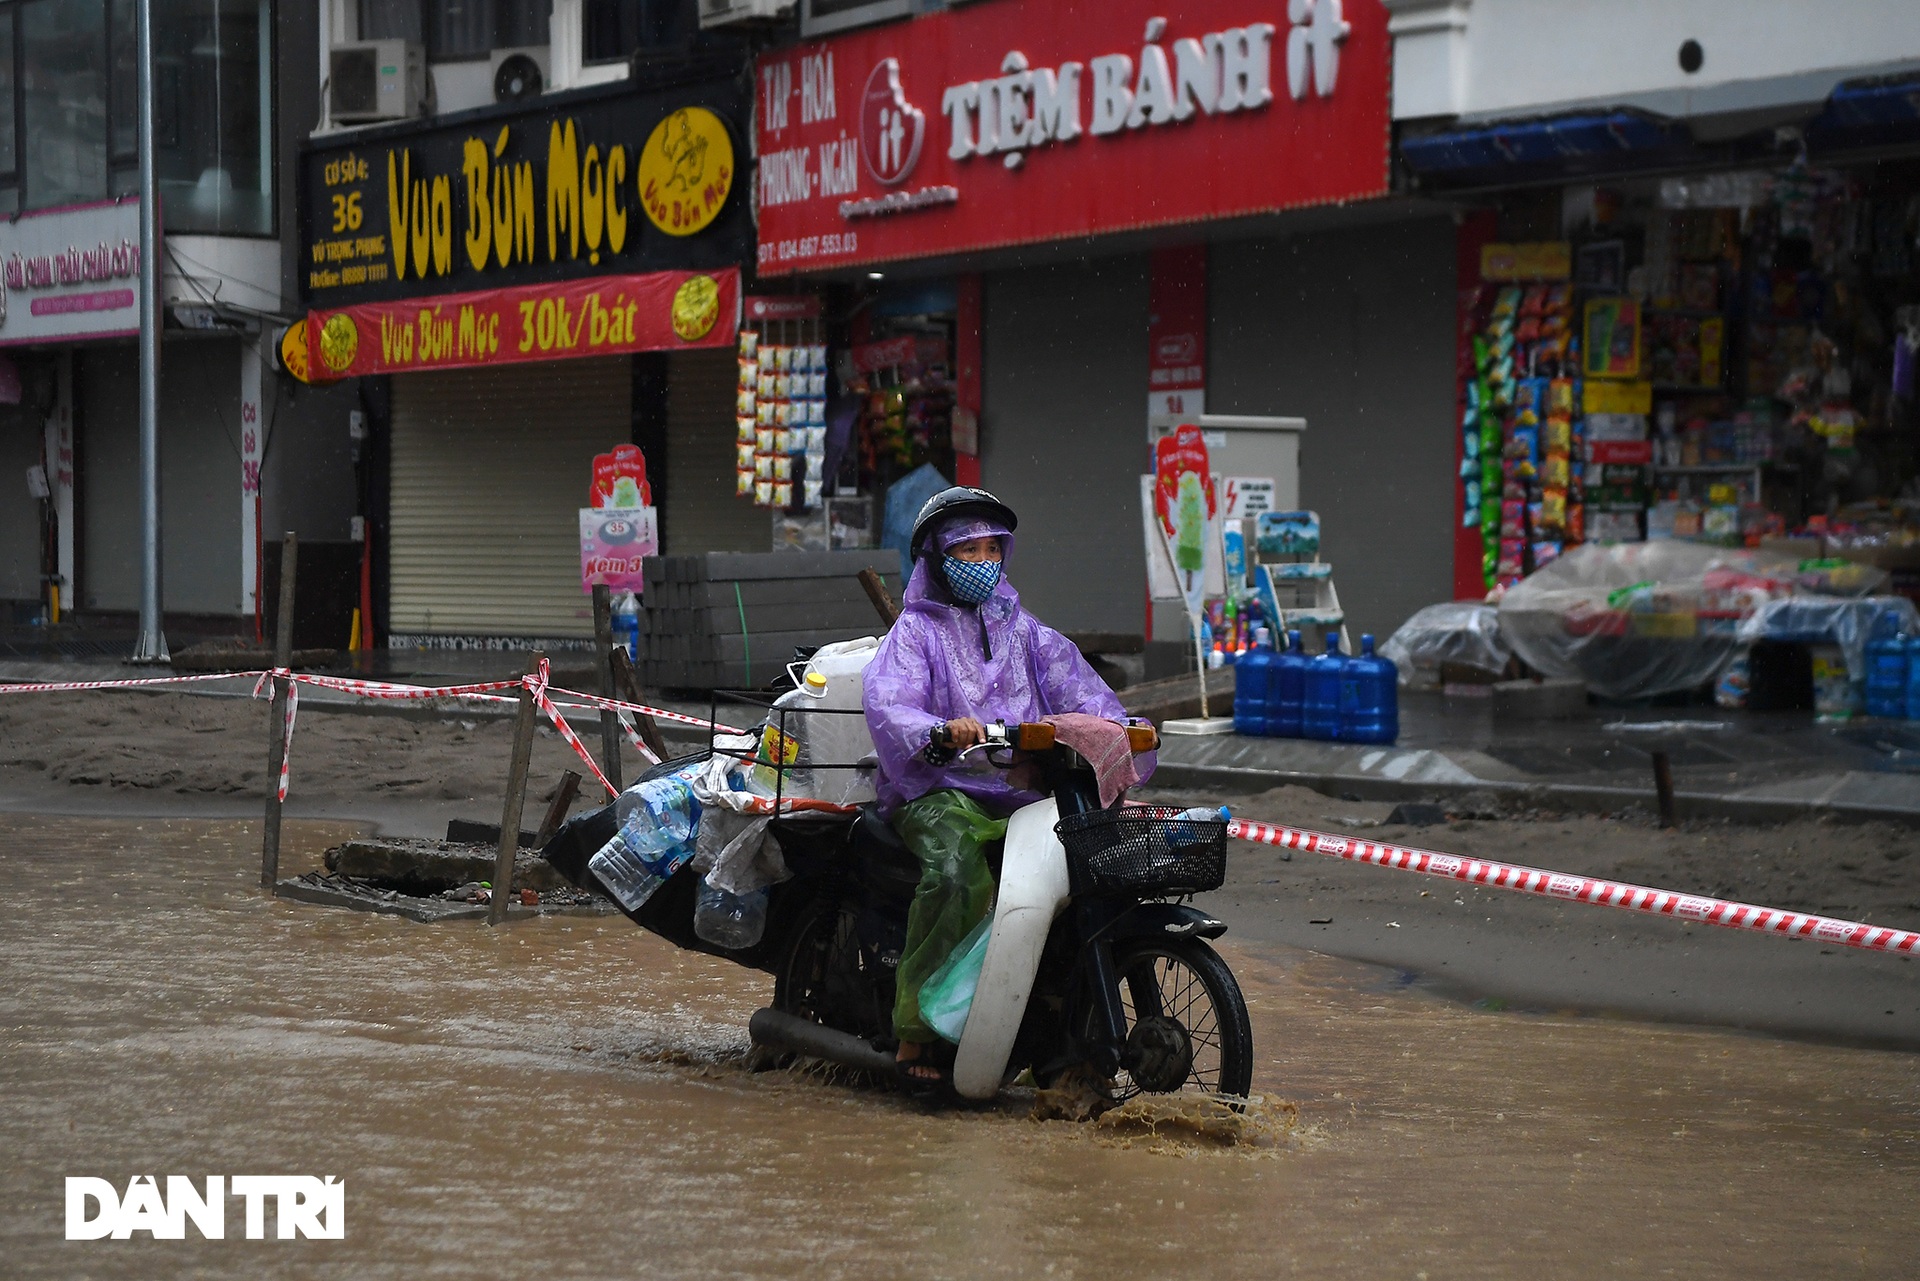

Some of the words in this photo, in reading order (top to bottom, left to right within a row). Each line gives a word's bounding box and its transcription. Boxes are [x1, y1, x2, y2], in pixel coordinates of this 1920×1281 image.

[763, 61, 792, 141] TẠP
[802, 43, 837, 125] HÓA
[942, 49, 1085, 169] TIỆM
[1090, 15, 1277, 136] BÁNH
[820, 129, 858, 197] NGÂN
[332, 190, 364, 234] 36
[388, 146, 452, 282] Vua
[462, 124, 535, 272] Bún
[547, 116, 627, 266] Mọc
[381, 311, 414, 366] Vua
[418, 302, 453, 363] Bún
[458, 303, 499, 361] Mọc
[518, 292, 639, 352] 30k/bát
[610, 521, 625, 534] 35
[585, 555, 627, 579] Kem
